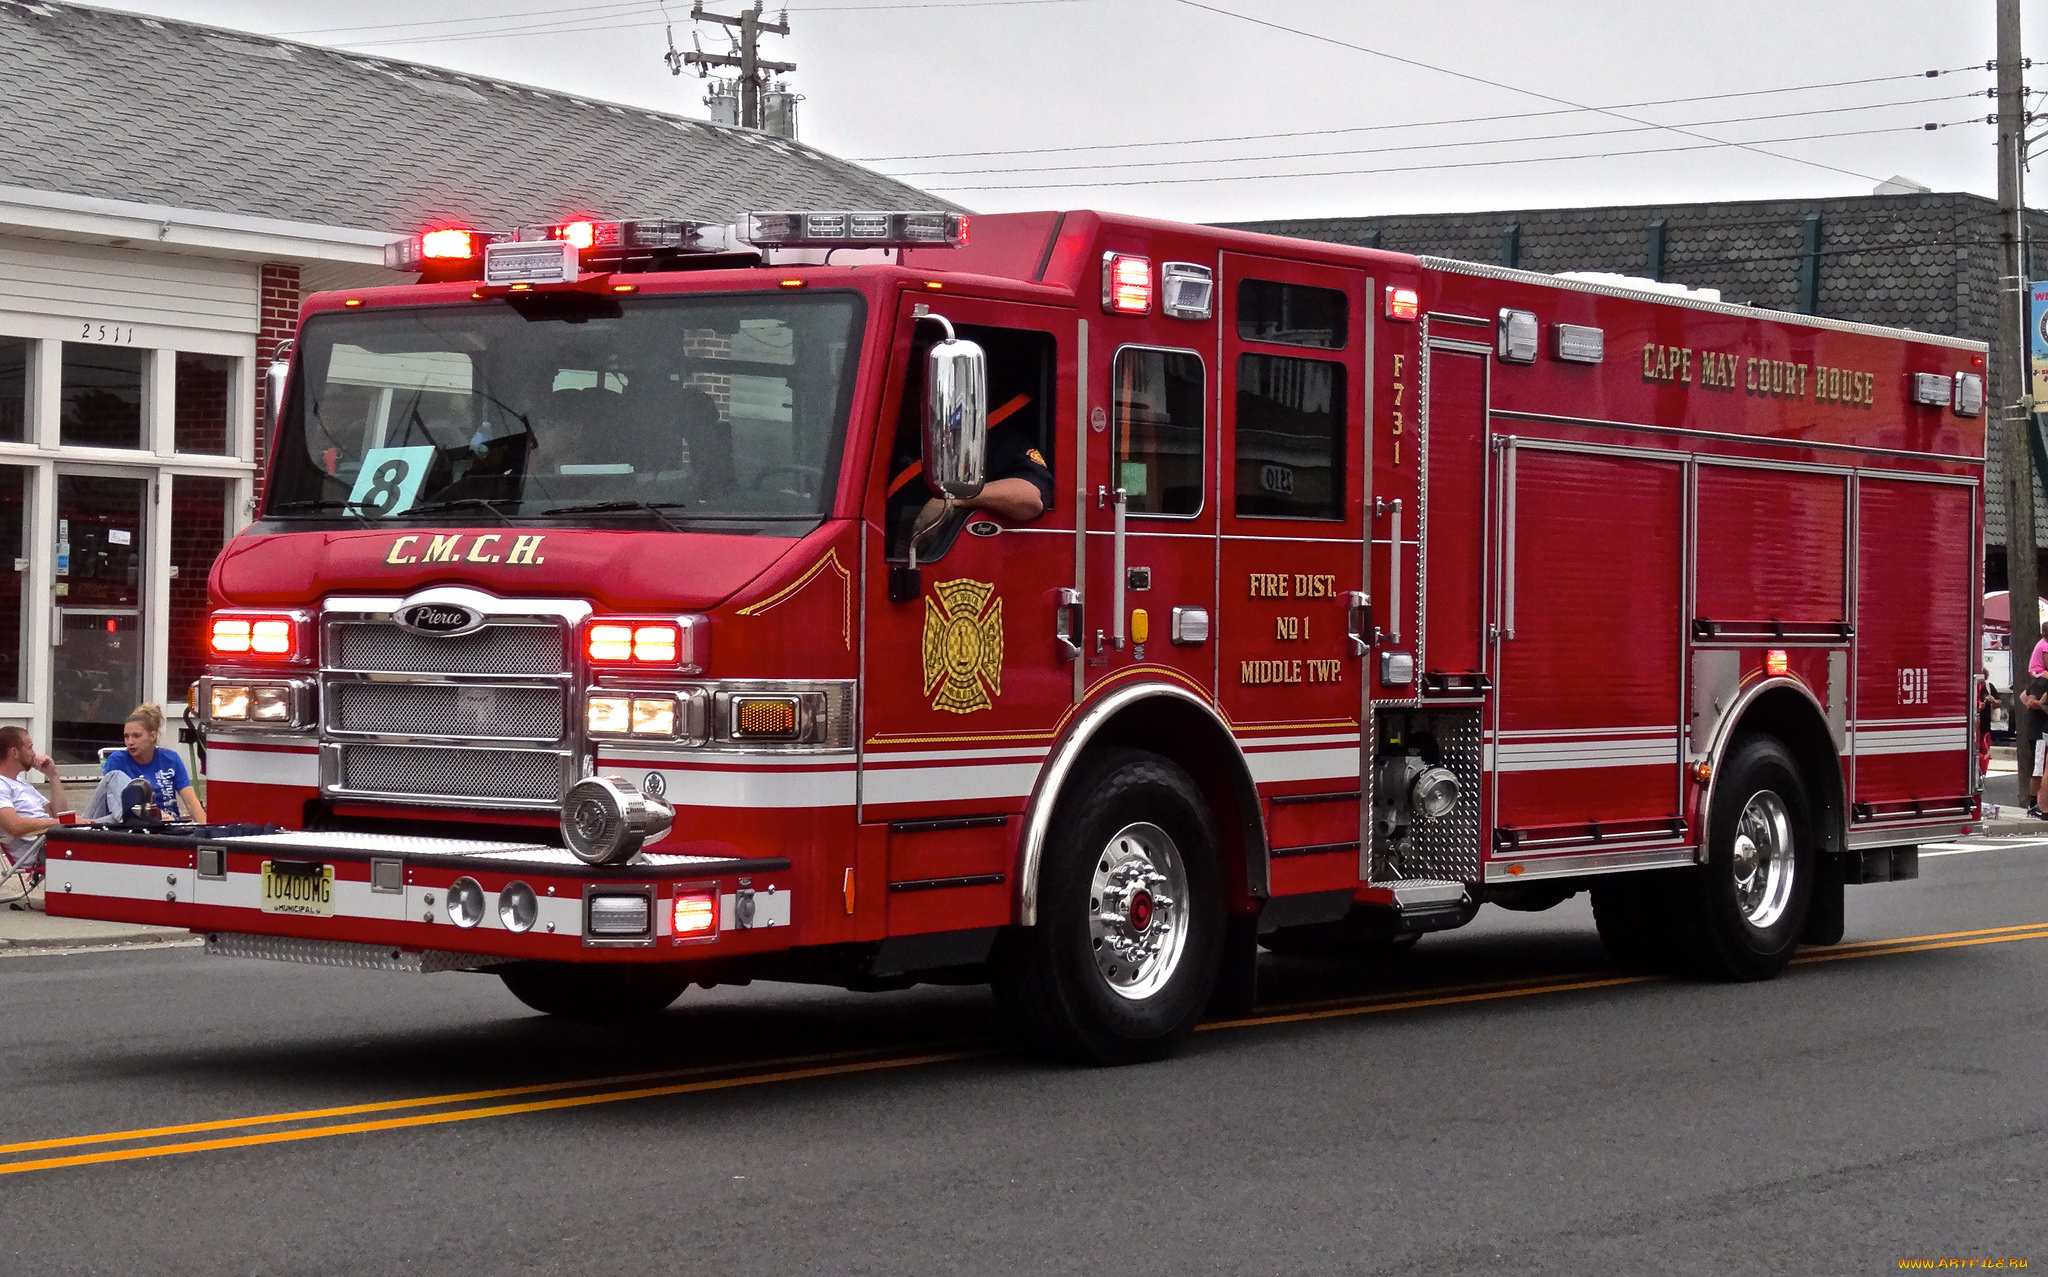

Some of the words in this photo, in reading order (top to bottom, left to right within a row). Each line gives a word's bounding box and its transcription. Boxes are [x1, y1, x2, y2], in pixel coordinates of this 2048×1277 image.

[82, 323, 133, 344] 2511
[1643, 343, 1692, 382] CAPE
[1702, 350, 1740, 387] MAY
[1747, 357, 1808, 396] COURT
[1816, 365, 1874, 404] HOUSE
[1392, 353, 1405, 464] F731
[361, 459, 410, 517] 8
[1250, 573, 1289, 597] FIRE
[1294, 574, 1337, 597] DIST.
[415, 606, 462, 627] Pierce
[1303, 616, 1310, 640] 1
[1241, 660, 1302, 684] MIDDLE
[1306, 659, 1342, 682] TWP.
[1902, 668, 1928, 705] 911
[278, 904, 315, 915] MUNICIPAL
